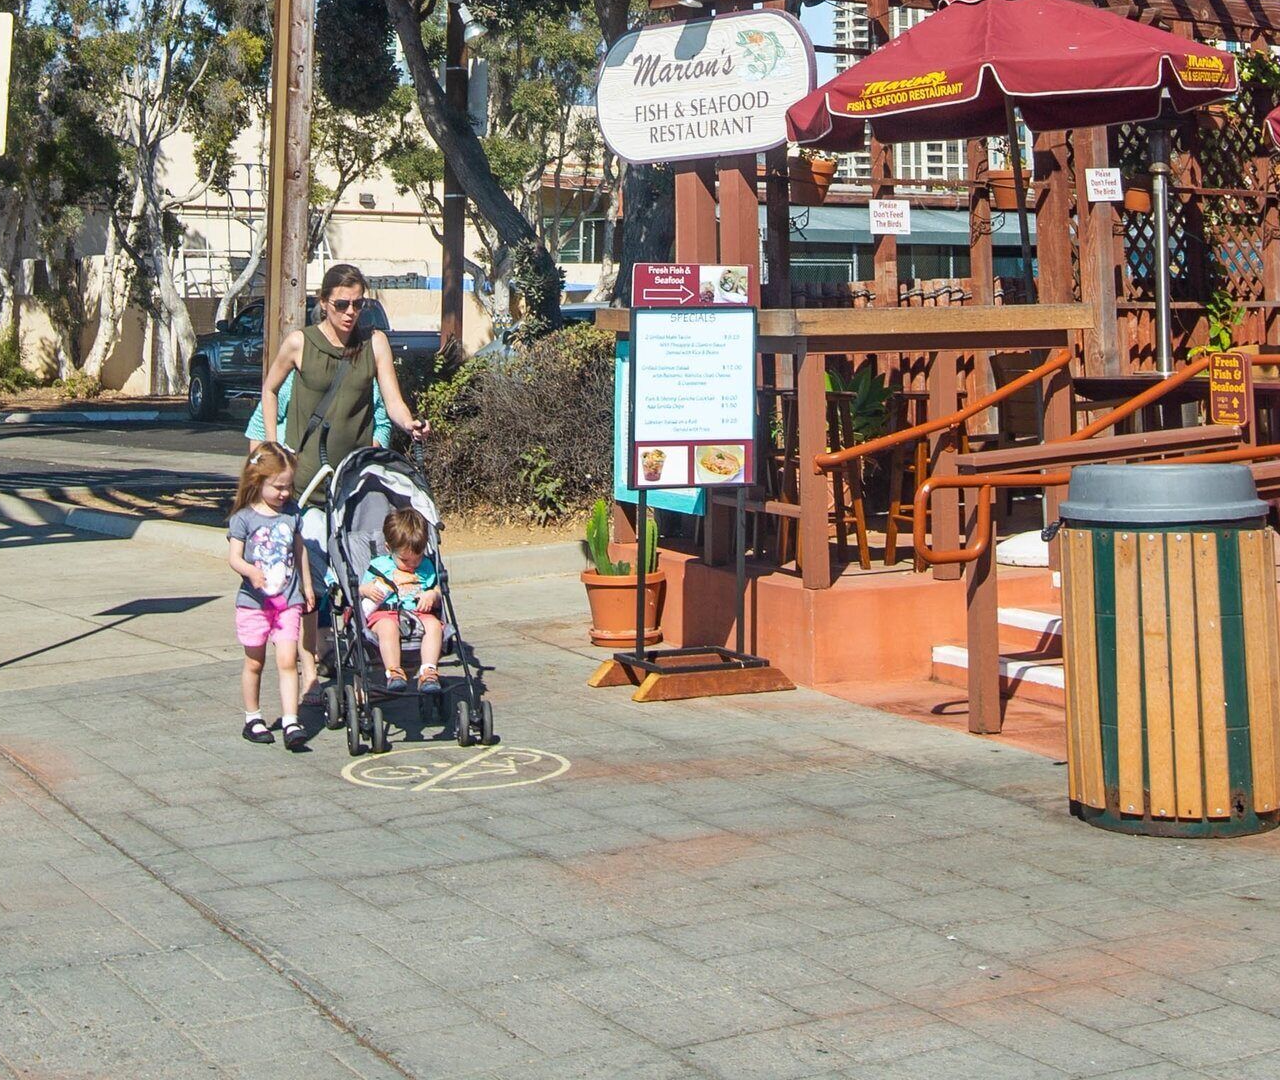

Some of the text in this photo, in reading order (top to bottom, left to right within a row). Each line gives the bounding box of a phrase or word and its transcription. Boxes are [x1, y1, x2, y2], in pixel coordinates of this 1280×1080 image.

[633, 49, 735, 87] Marion's
[847, 83, 964, 112] FISH & SEAFOOD RESTAURANT
[635, 91, 769, 123] FISH & SEAFOOD
[649, 116, 755, 143] RESTAURANT
[1095, 170, 1111, 178] Please
[1091, 179, 1104, 187] Don't
[879, 201, 897, 209] Please
[873, 210, 904, 218] Don't Feed
[887, 220, 902, 228] Birds
[648, 266, 691, 275] Fresh Fish &
[654, 275, 685, 285] Seafood
[670, 312, 716, 323] SPECIALS
[1214, 356, 1239, 367] Fresh
[1213, 369, 1241, 380] Fish &
[1211, 381, 1246, 393] Seafood
